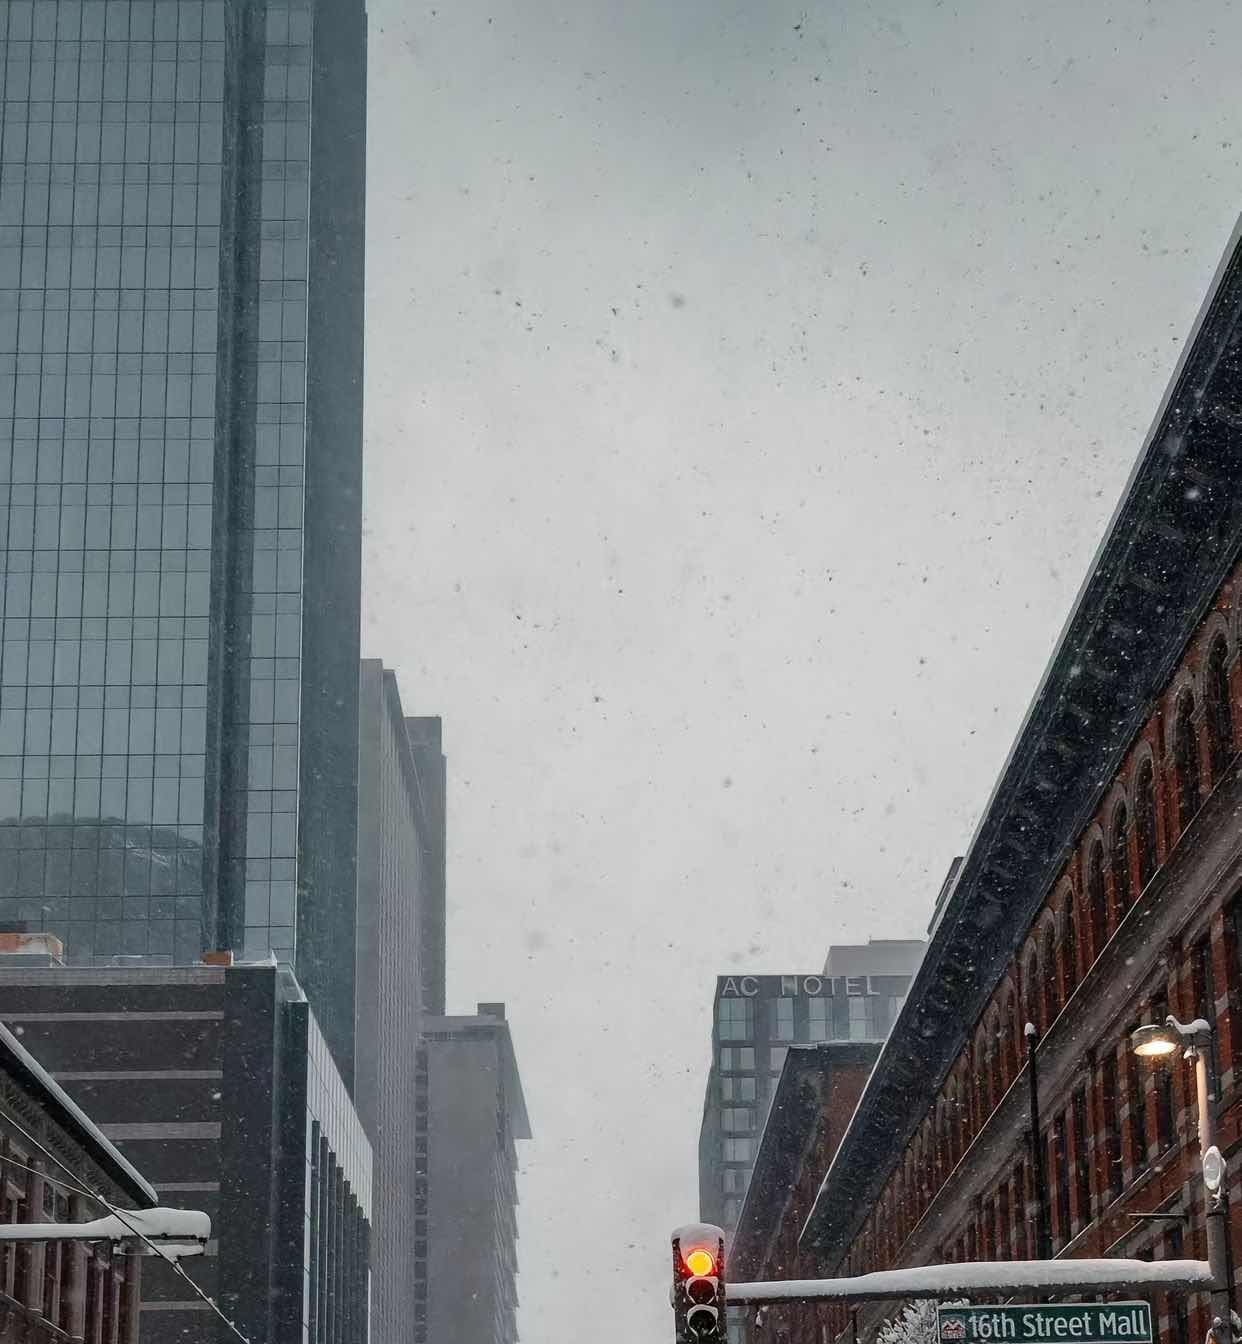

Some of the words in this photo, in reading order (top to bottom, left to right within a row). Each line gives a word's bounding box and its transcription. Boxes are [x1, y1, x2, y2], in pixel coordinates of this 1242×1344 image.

[722, 976, 759, 996] AC
[781, 976, 880, 996] HOTEL
[968, 1312, 1016, 1338] 16th
[1023, 1312, 1093, 1337] Street
[1099, 1310, 1147, 1336] Mall
